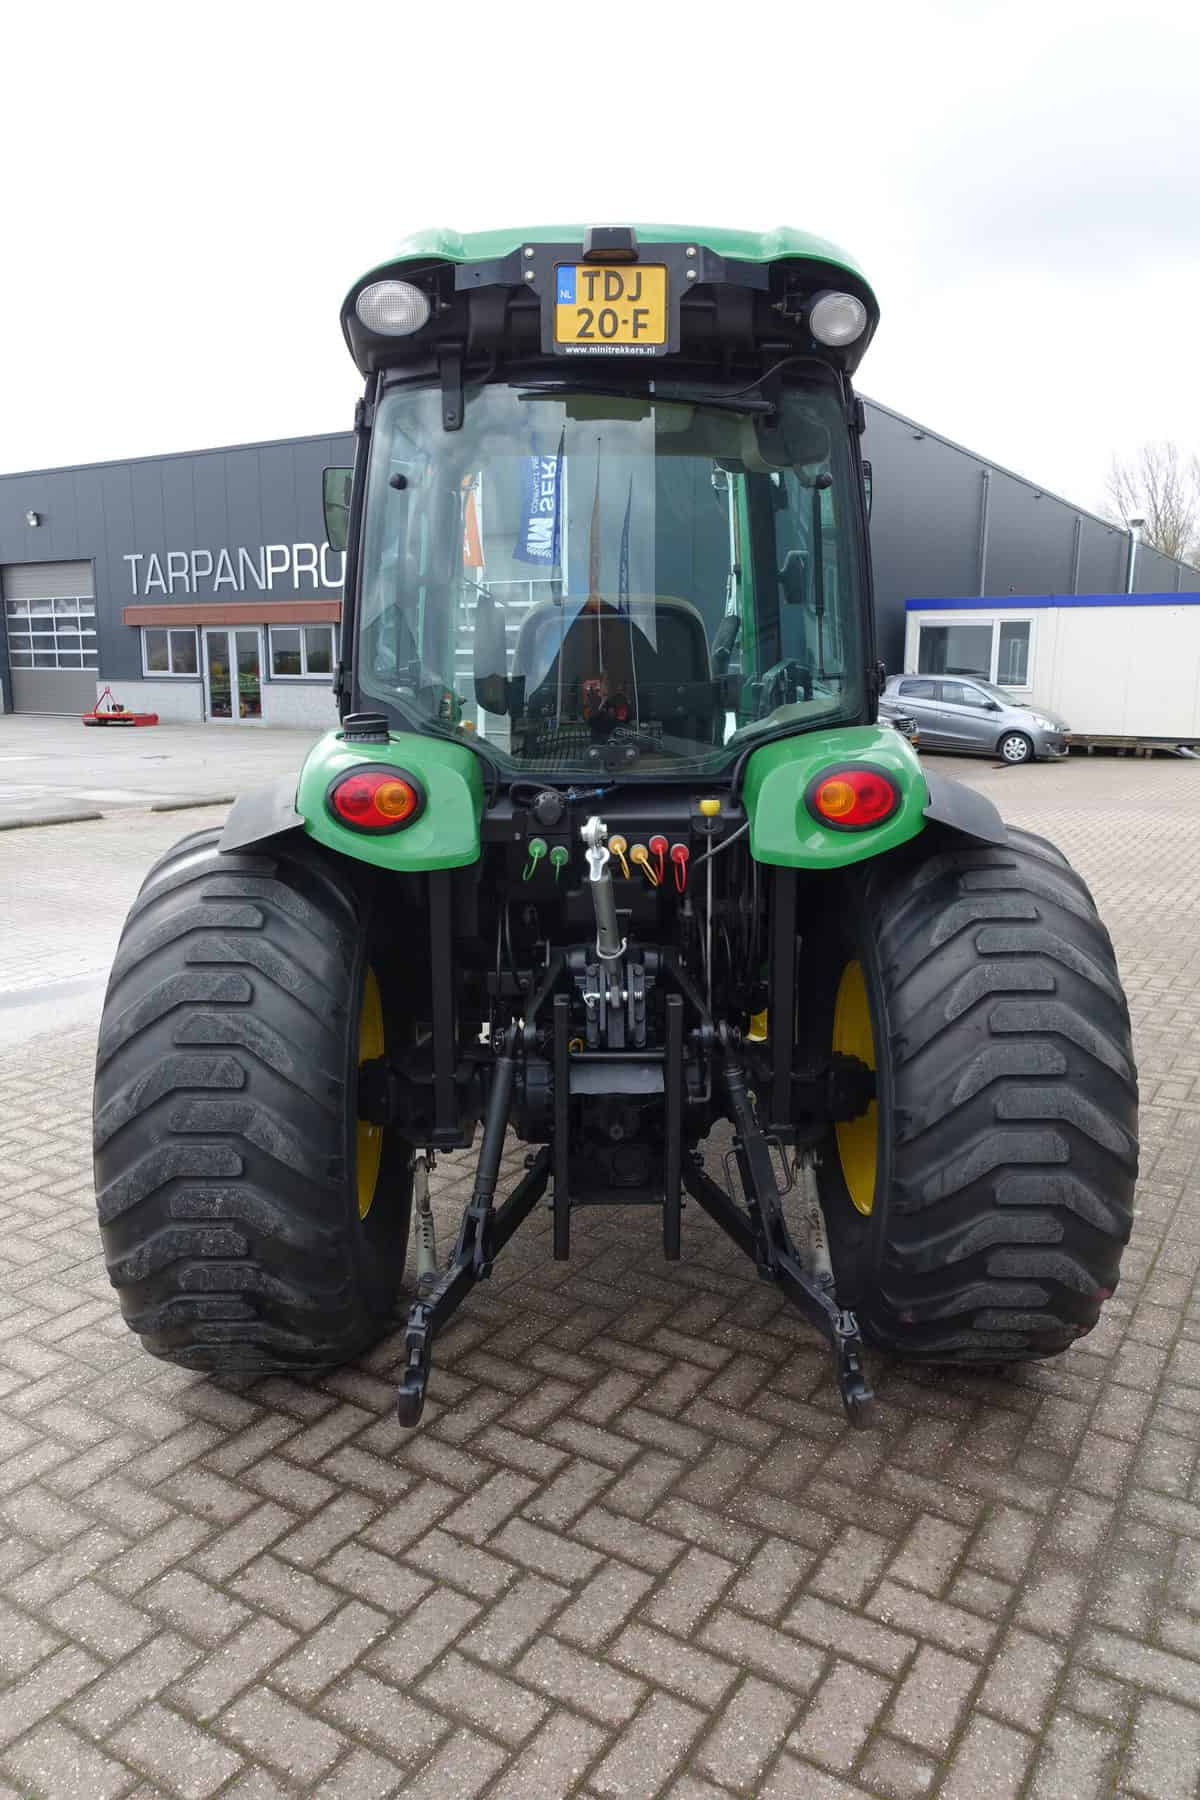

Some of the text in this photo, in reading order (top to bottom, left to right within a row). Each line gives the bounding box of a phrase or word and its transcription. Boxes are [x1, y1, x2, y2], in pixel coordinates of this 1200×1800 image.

[560, 289, 573, 299] NL
[582, 270, 642, 302] TDJ
[576, 307, 650, 339] 20-F
[565, 345, 656, 355] www.minitrekkers.nl
